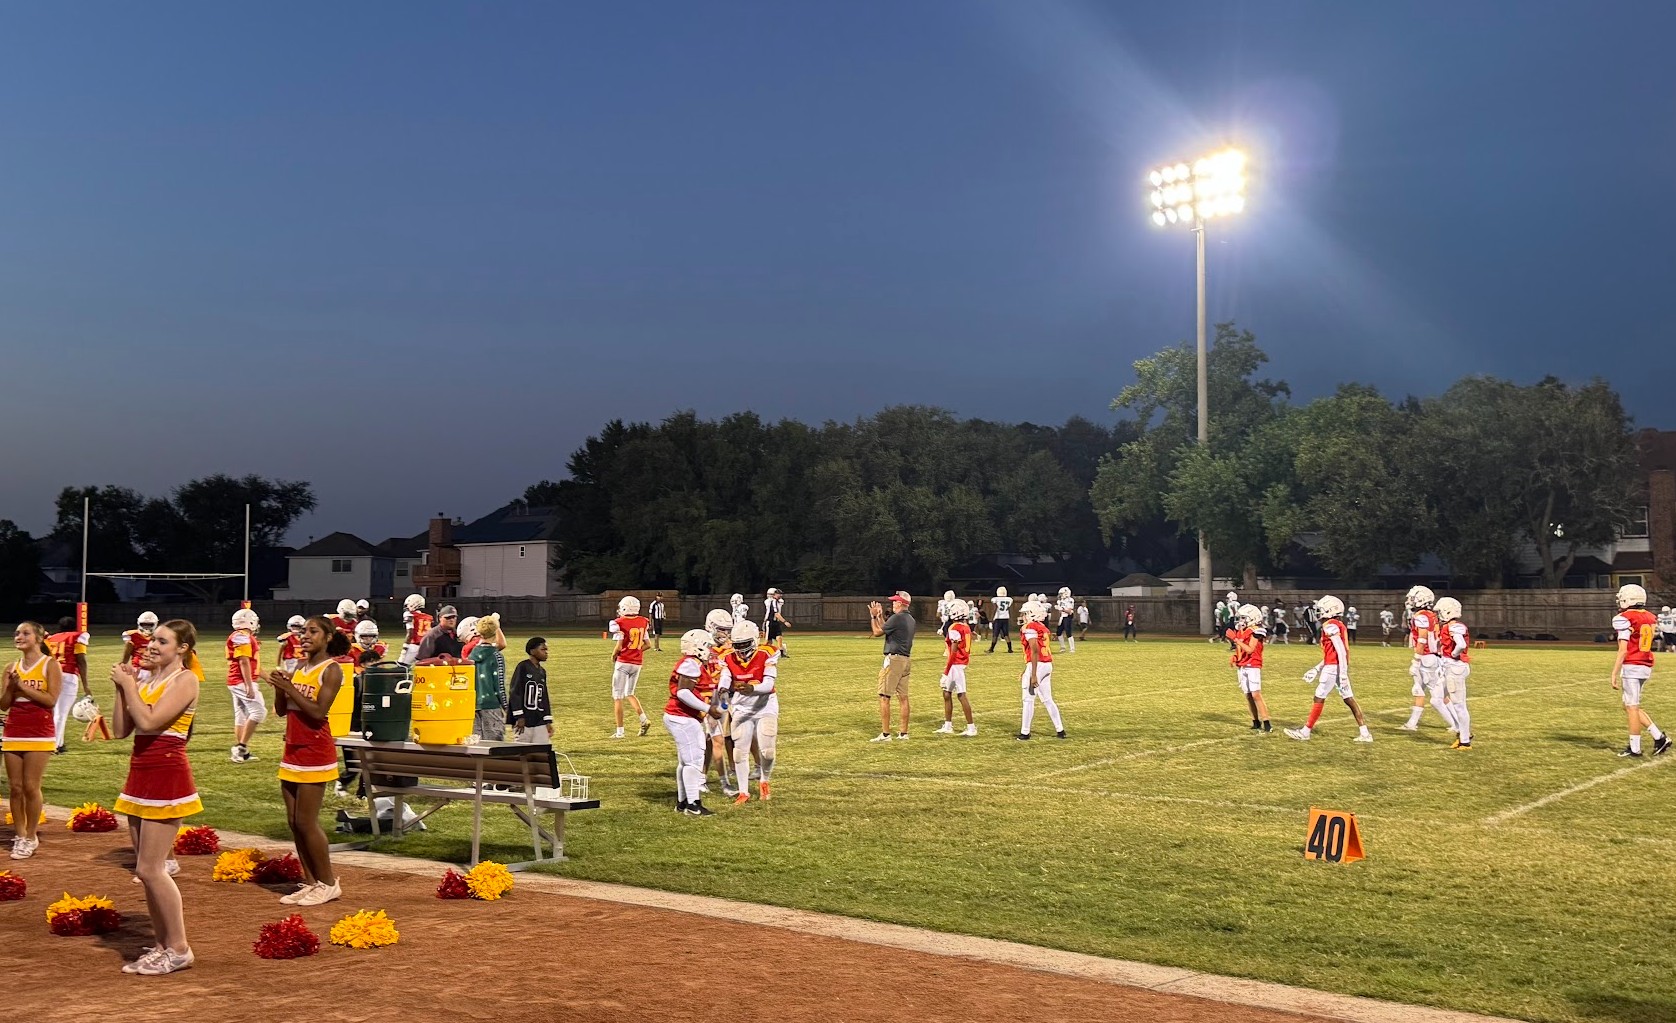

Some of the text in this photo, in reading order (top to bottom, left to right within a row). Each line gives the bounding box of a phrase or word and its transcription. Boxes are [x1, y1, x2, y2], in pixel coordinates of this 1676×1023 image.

[999, 601, 1010, 612] 57
[628, 627, 645, 650] 91
[1307, 814, 1346, 863] 40
